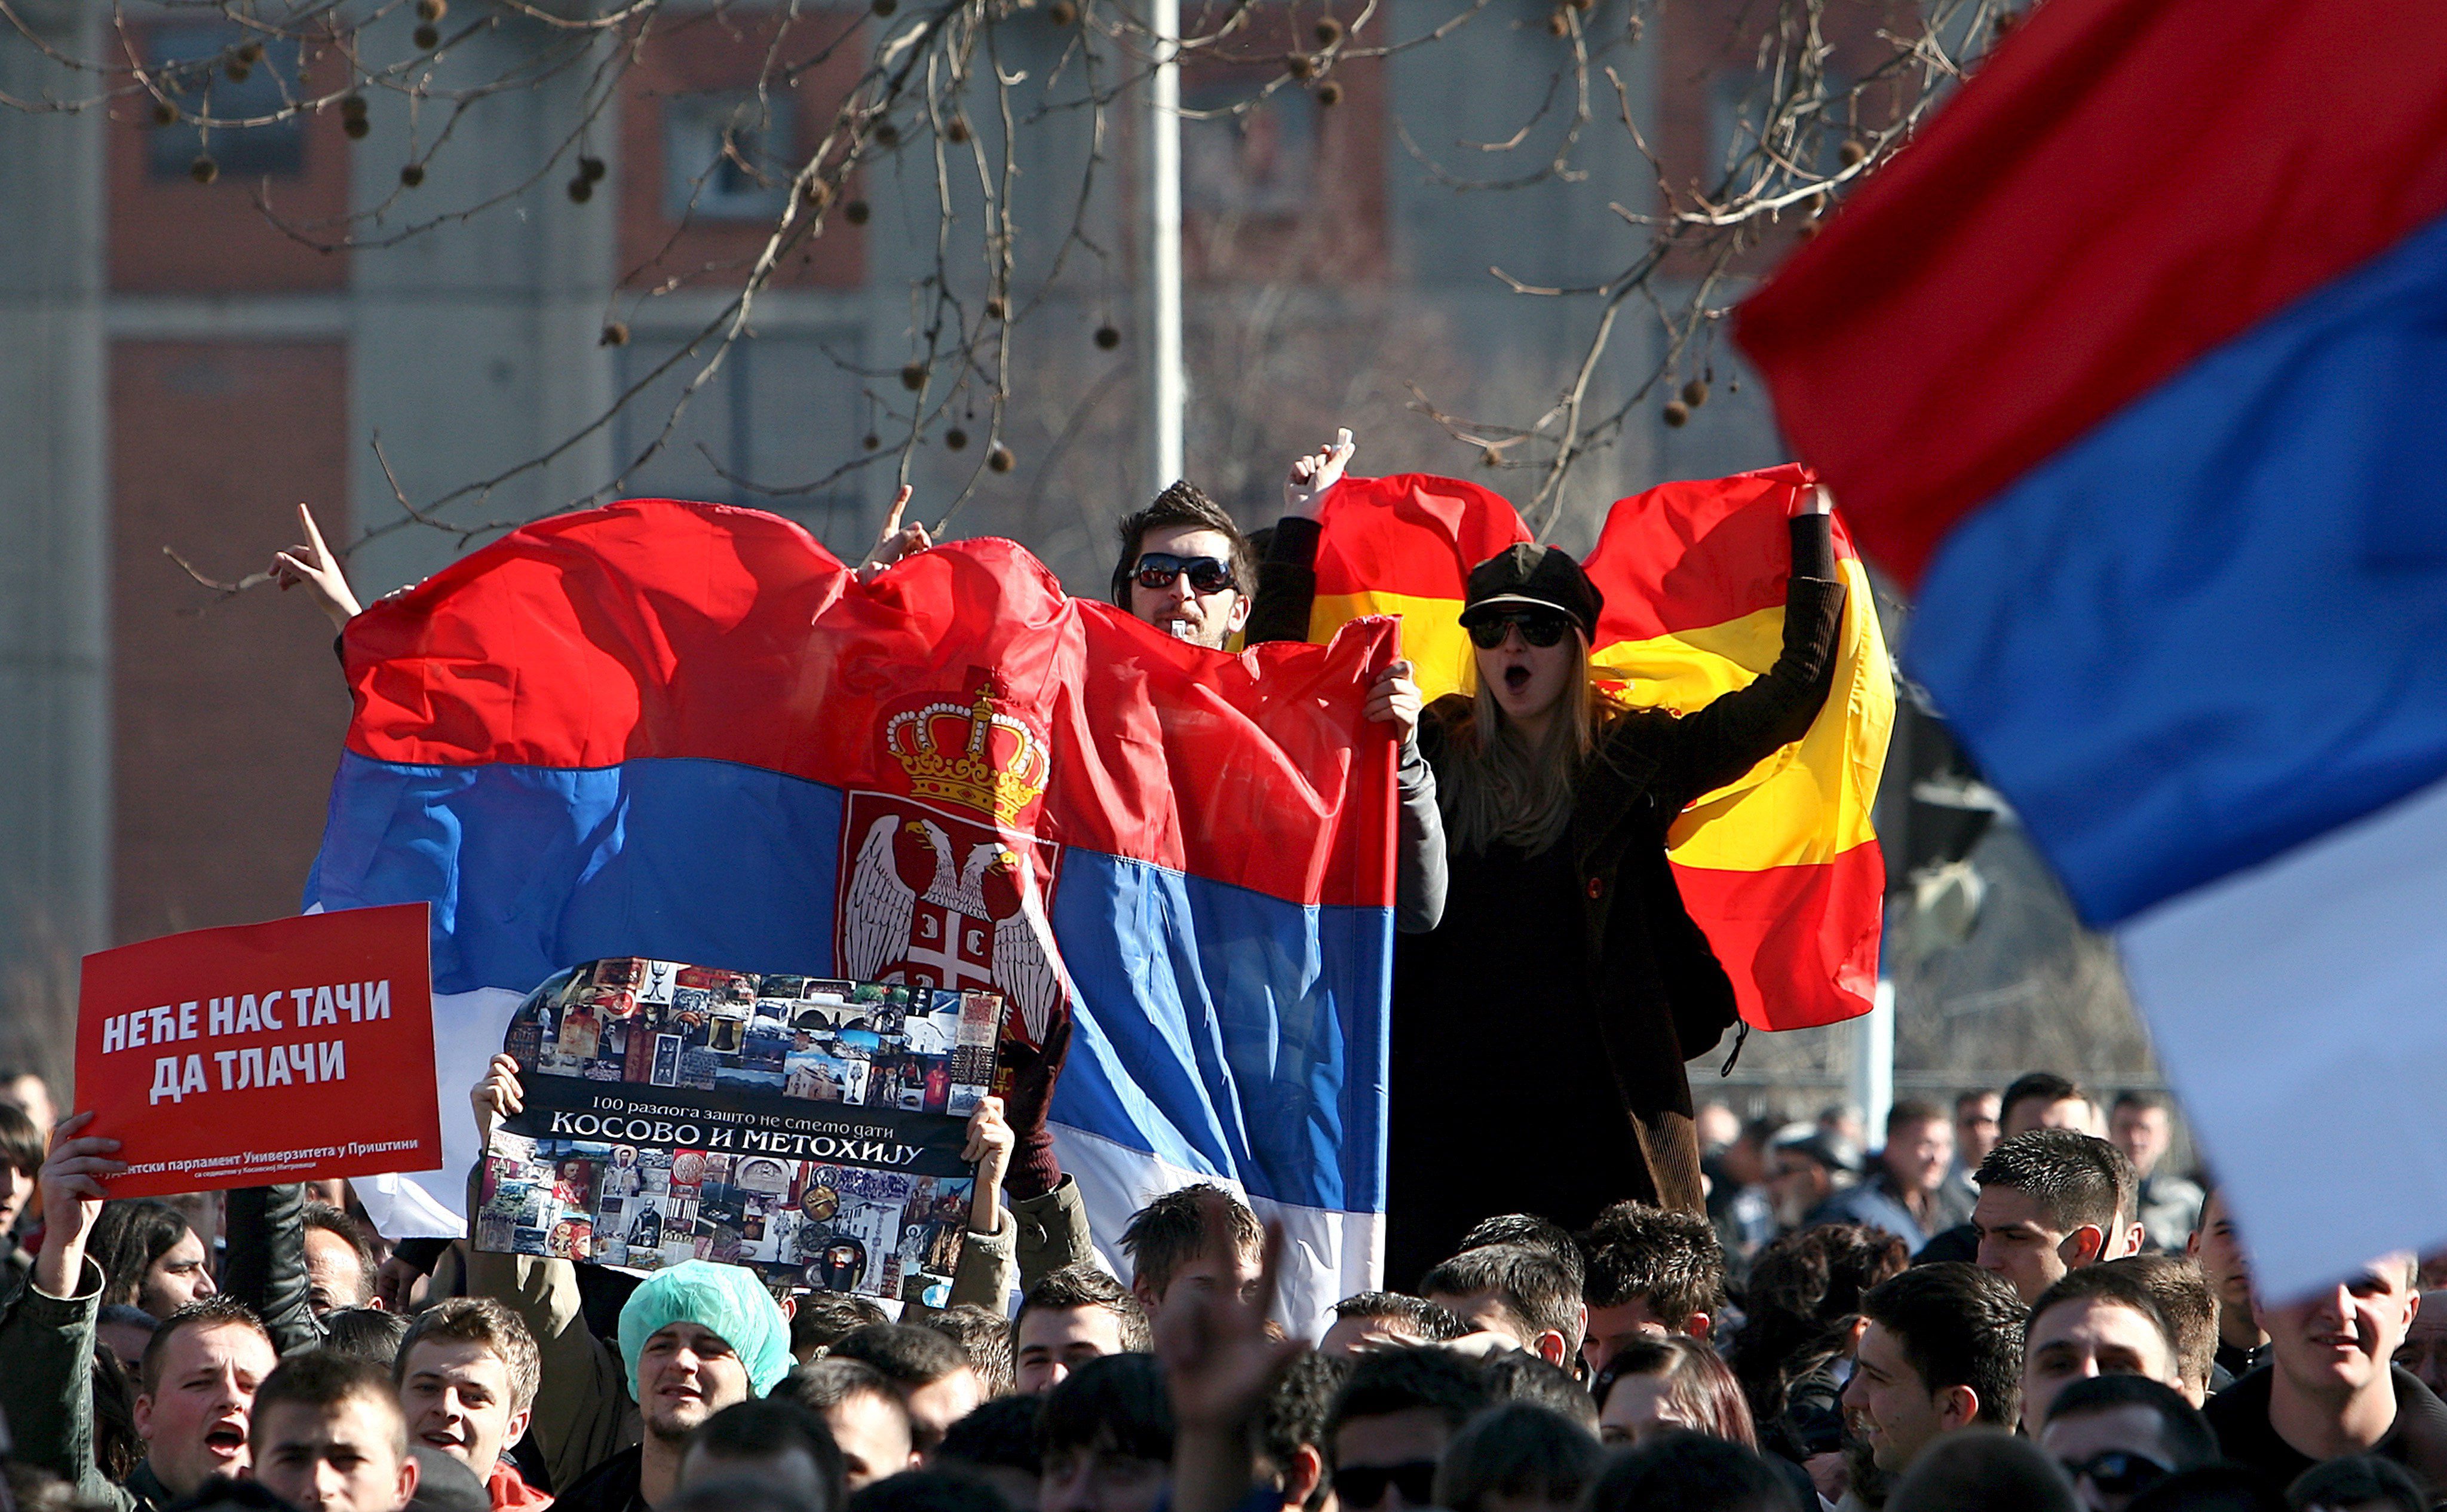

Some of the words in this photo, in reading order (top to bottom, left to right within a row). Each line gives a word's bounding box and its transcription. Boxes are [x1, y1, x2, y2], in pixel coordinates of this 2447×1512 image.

[102, 1001, 198, 1054] НЕЋЕ
[208, 990, 283, 1037] НАС
[290, 979, 391, 1028] ТАЧИ
[149, 1053, 208, 1106] ДА
[213, 1039, 346, 1092] ТЛАЧИ
[549, 1110, 701, 1145] КОСОВО
[708, 1126, 735, 1148] И
[741, 1128, 925, 1166] МЕТОХИЈУ
[592, 1096, 624, 1111] 100
[627, 1102, 700, 1119] разлога
[703, 1109, 756, 1125] зашто
[759, 1114, 781, 1128] не
[784, 1117, 851, 1134] смемо
[853, 1123, 895, 1139] дати
[92, 1161, 165, 1180] нтски
[167, 1155, 241, 1171] парламент
[243, 1146, 335, 1164] Универзитета
[338, 1145, 346, 1158] у
[347, 1139, 419, 1157] Приштини
